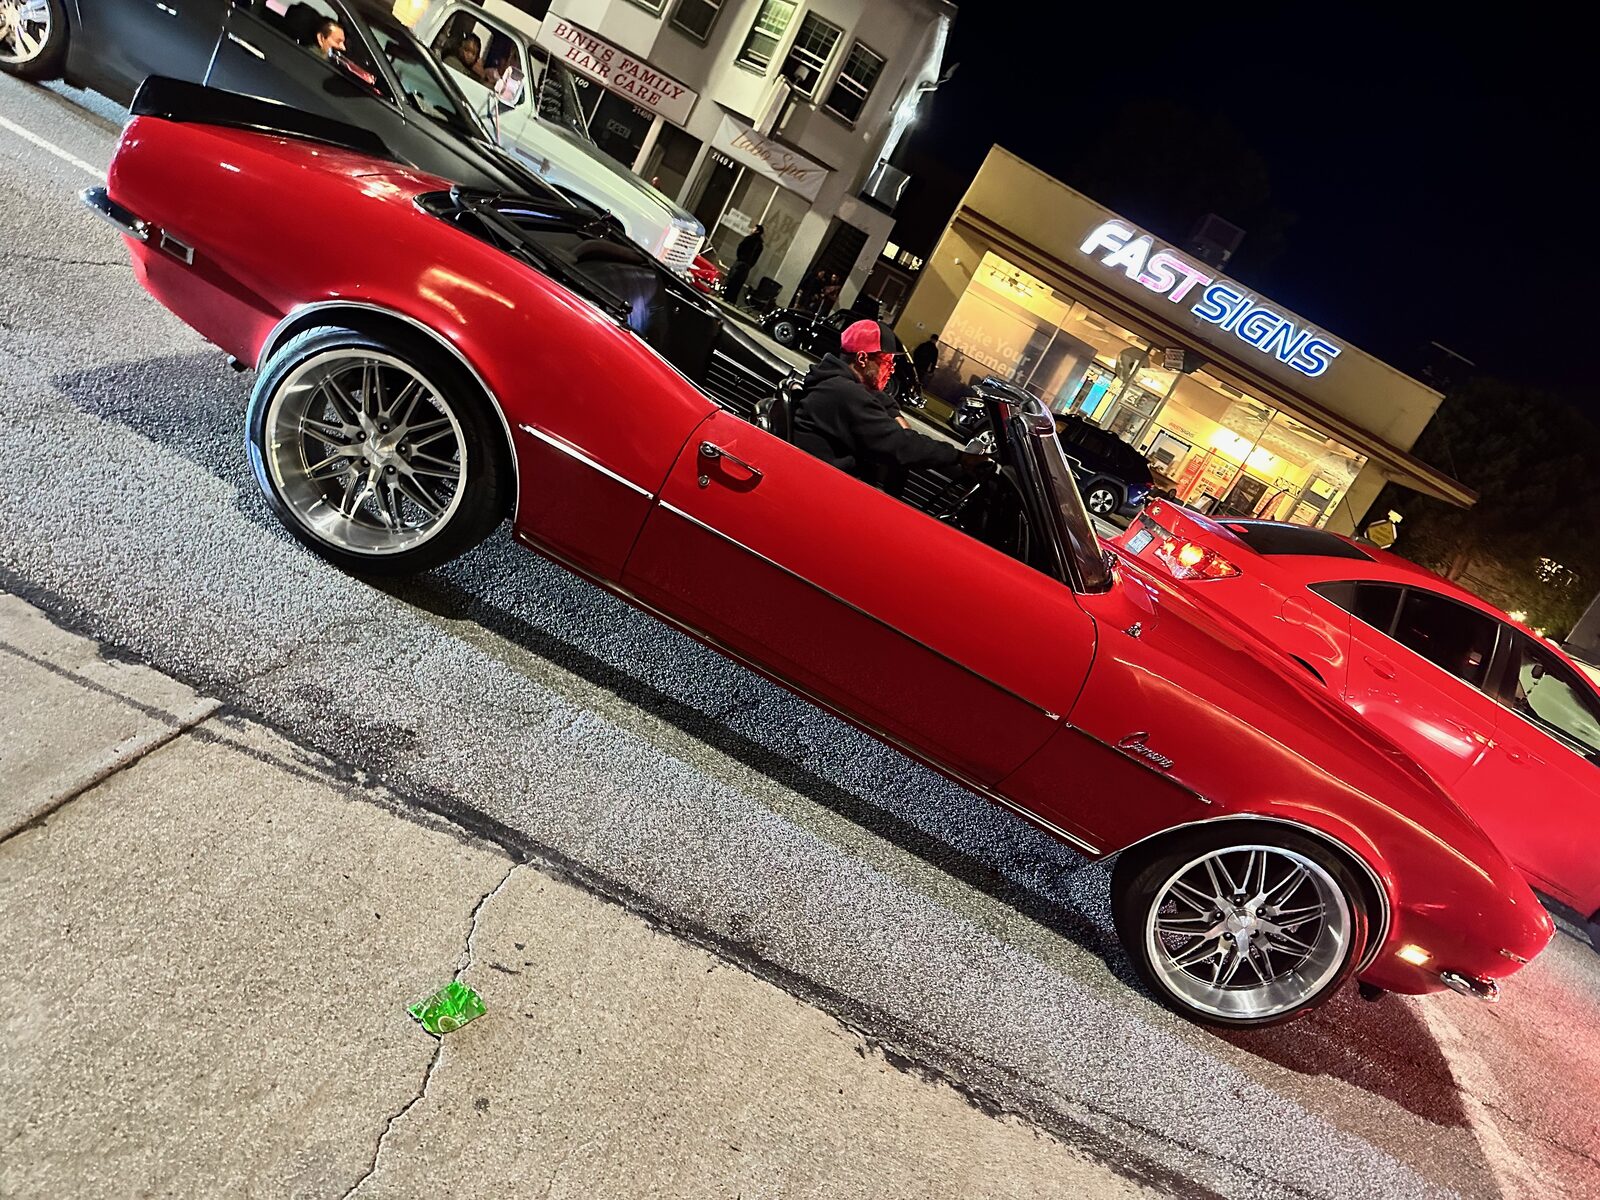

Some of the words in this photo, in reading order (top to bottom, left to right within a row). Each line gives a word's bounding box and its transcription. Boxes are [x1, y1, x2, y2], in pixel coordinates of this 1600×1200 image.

[553, 22, 615, 62] BINH'S
[618, 57, 686, 100] FAMILY
[565, 47, 611, 78] HAIR
[613, 73, 662, 106] CARE
[711, 151, 728, 166] 2140
[727, 160, 735, 170] A
[771, 152, 808, 184] Spa
[943, 330, 1026, 384] Statement
[950, 317, 993, 346] Make
[996, 337, 1031, 367] Your
